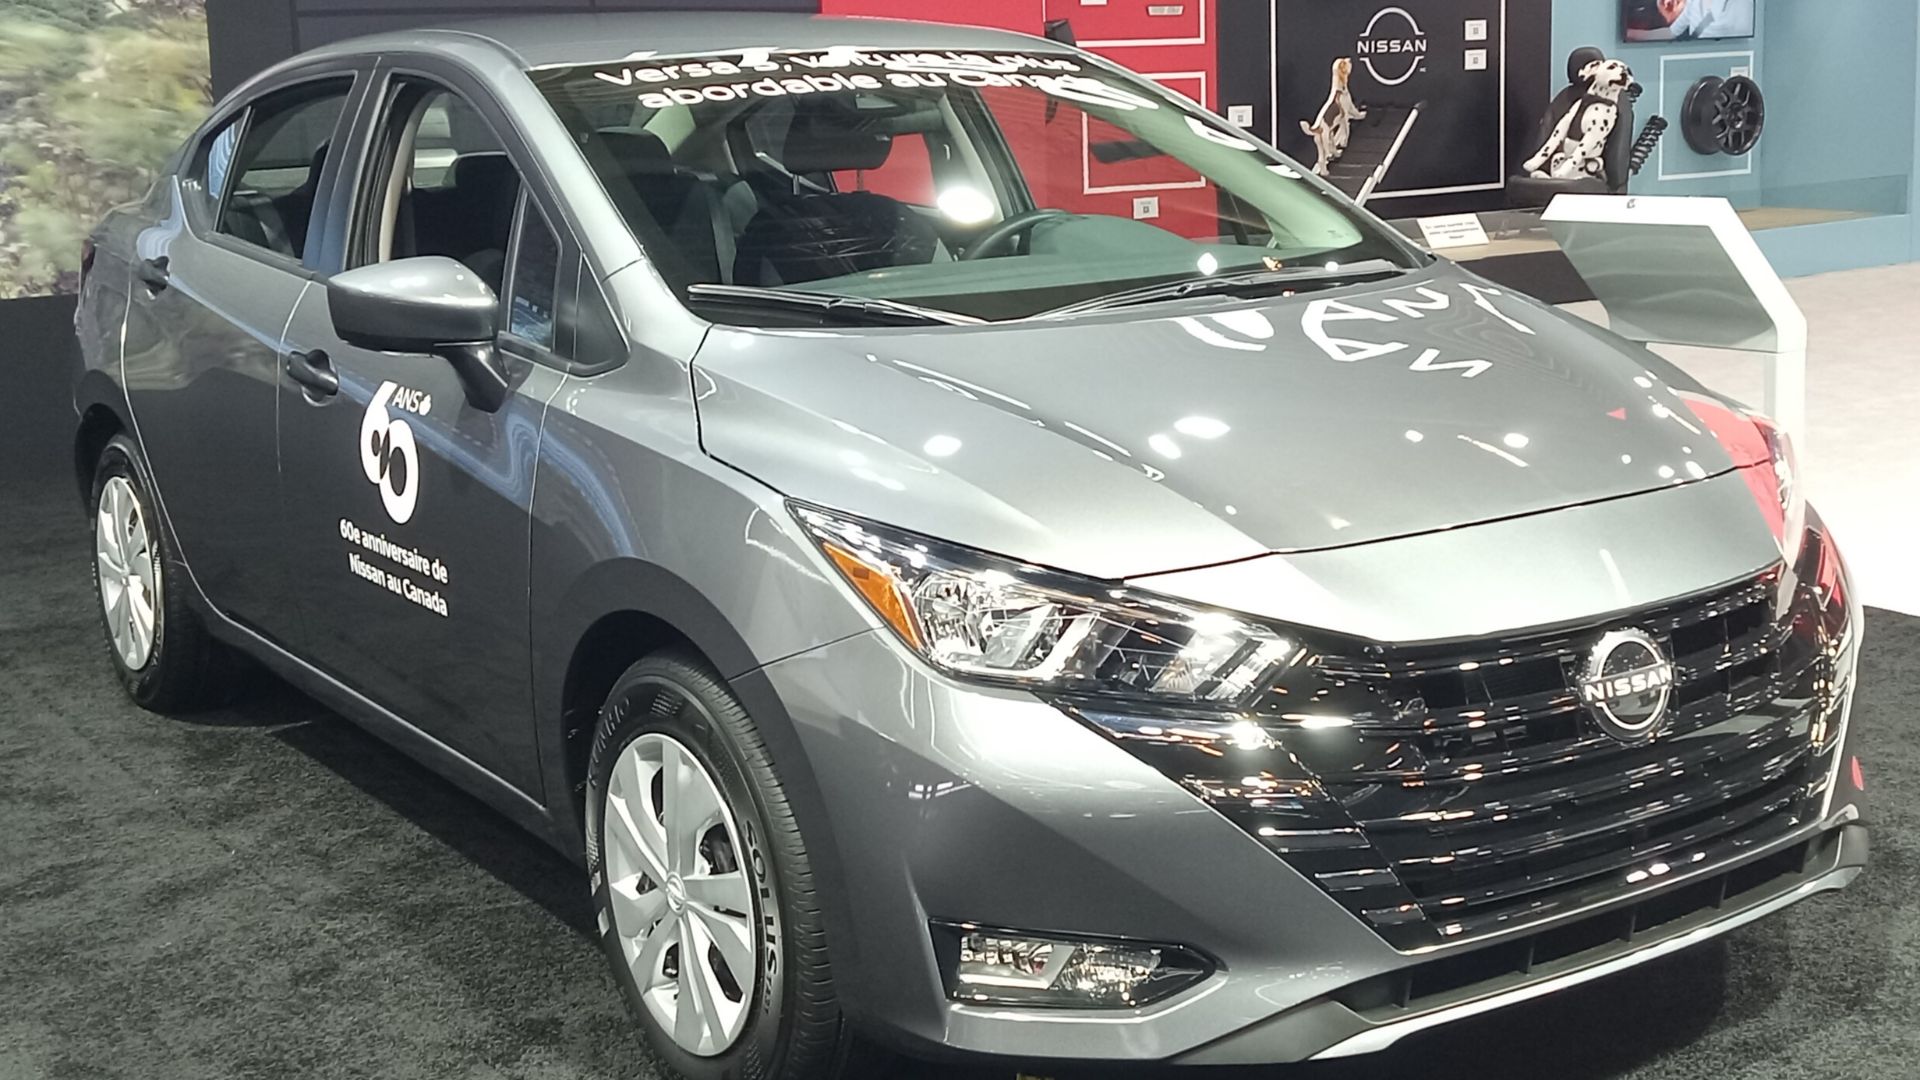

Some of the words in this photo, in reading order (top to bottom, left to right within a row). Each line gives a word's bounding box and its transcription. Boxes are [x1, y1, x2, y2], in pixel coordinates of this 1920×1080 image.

[1357, 39, 1427, 54] NISSAN
[594, 60, 742, 87] Versa
[992, 55, 1080, 72] plus
[638, 72, 882, 108] abordable
[886, 72, 948, 88] au
[392, 386, 421, 413] ANS
[360, 380, 419, 524] 60
[339, 518, 362, 544] 60e
[361, 531, 431, 578] anniversaire
[431, 556, 449, 585] de
[348, 552, 386, 589] Nissan
[386, 573, 402, 596] au
[402, 578, 449, 618] Canada
[1584, 665, 1673, 701] NISSAN
[744, 820, 777, 975] SOLUS
